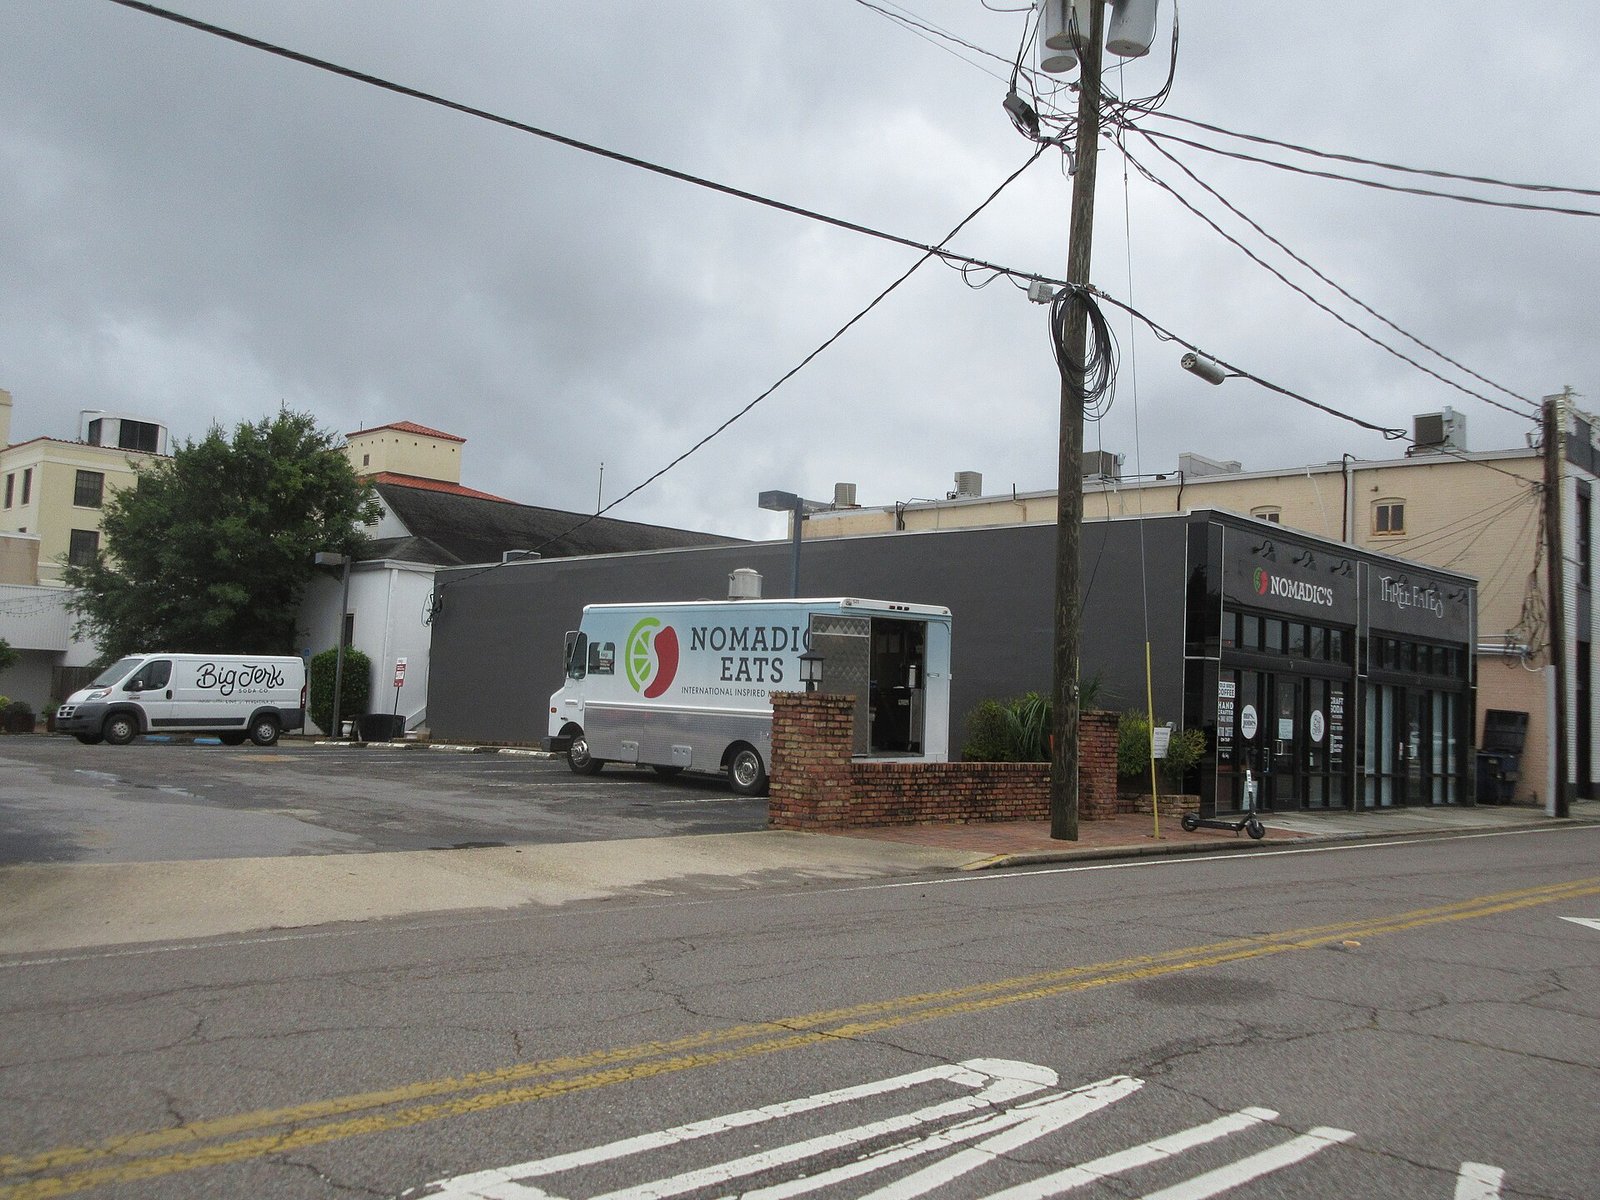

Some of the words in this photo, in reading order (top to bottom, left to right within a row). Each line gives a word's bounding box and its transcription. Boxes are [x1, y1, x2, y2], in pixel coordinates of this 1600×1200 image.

[1270, 575, 1333, 607] NOMADIC'S
[196, 662, 237, 696] Big
[238, 663, 285, 689] Jerk
[720, 656, 784, 683] EATS
[681, 686, 733, 697] INTERNATIONAL
[734, 688, 766, 698] INSPIRED
